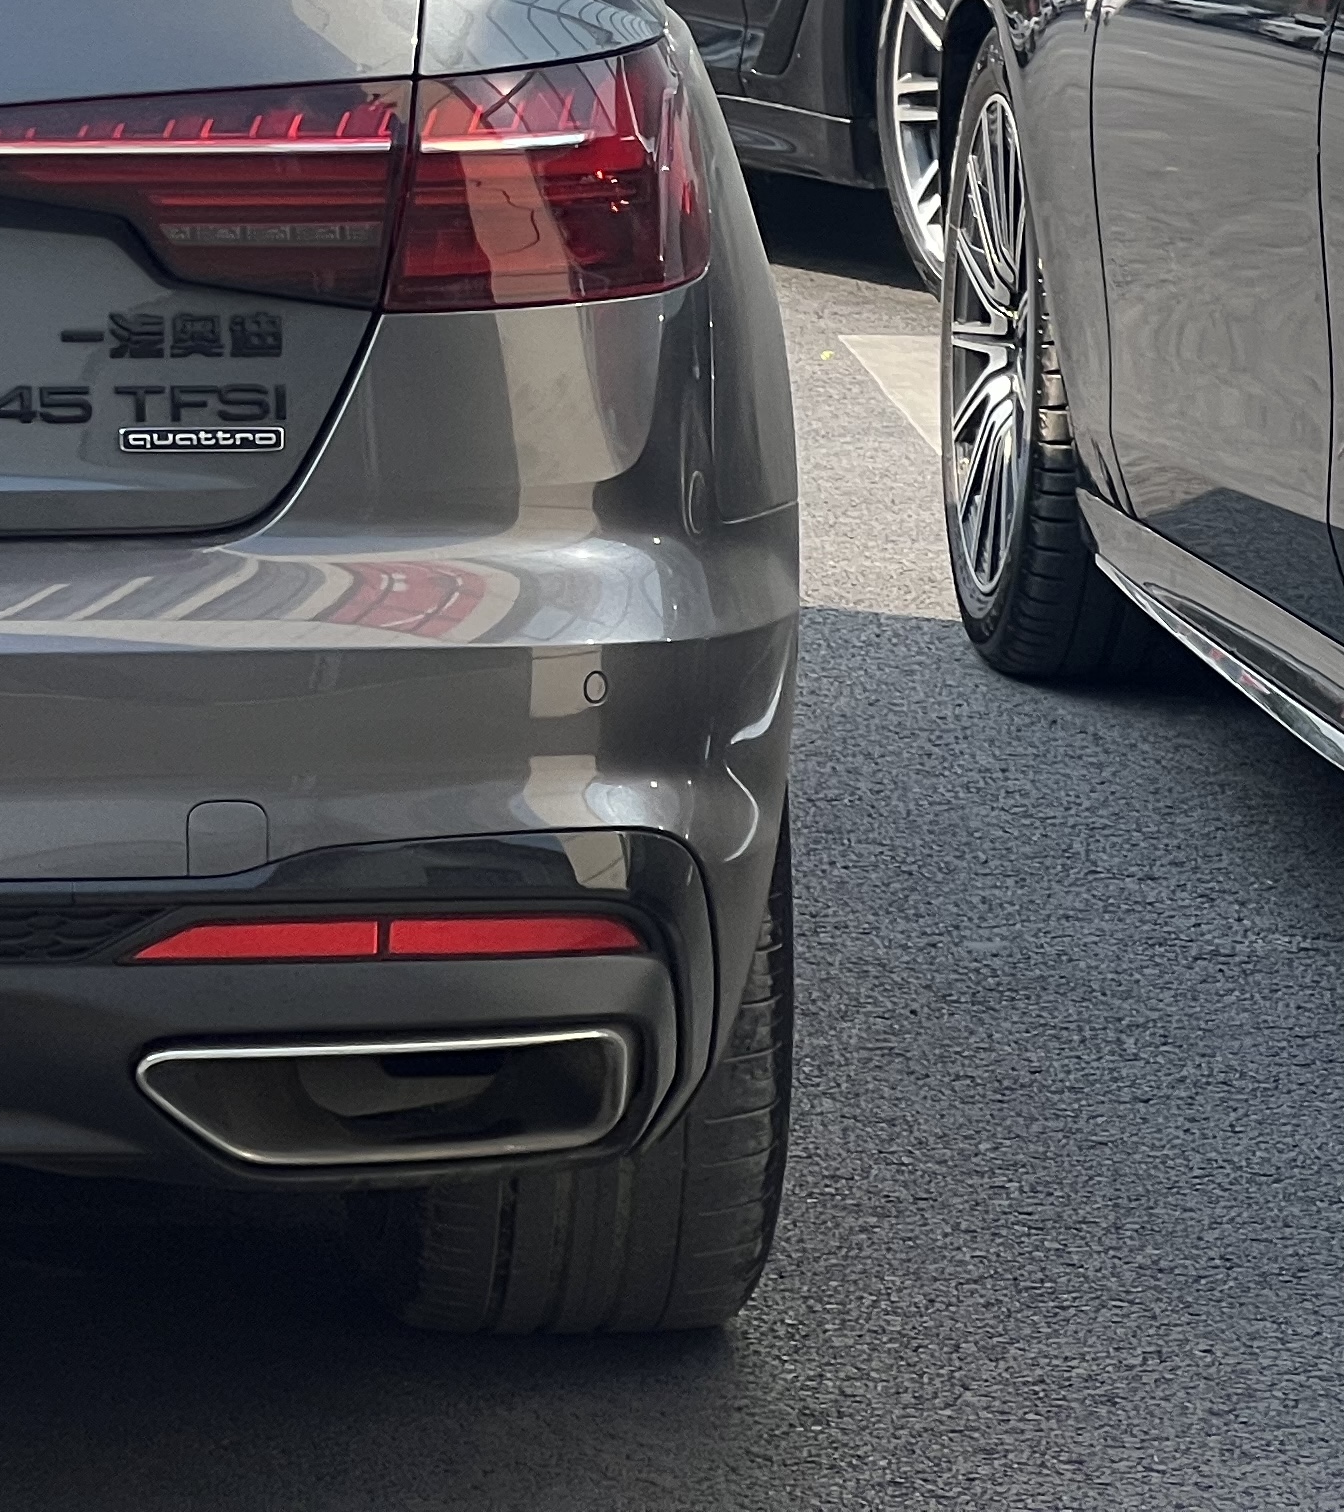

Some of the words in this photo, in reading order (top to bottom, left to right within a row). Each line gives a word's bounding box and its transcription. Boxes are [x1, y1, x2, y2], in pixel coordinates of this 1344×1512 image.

[59, 312, 283, 359] 一汽奥迪
[114, 383, 287, 423] TFSI
[127, 430, 277, 450] quattro
